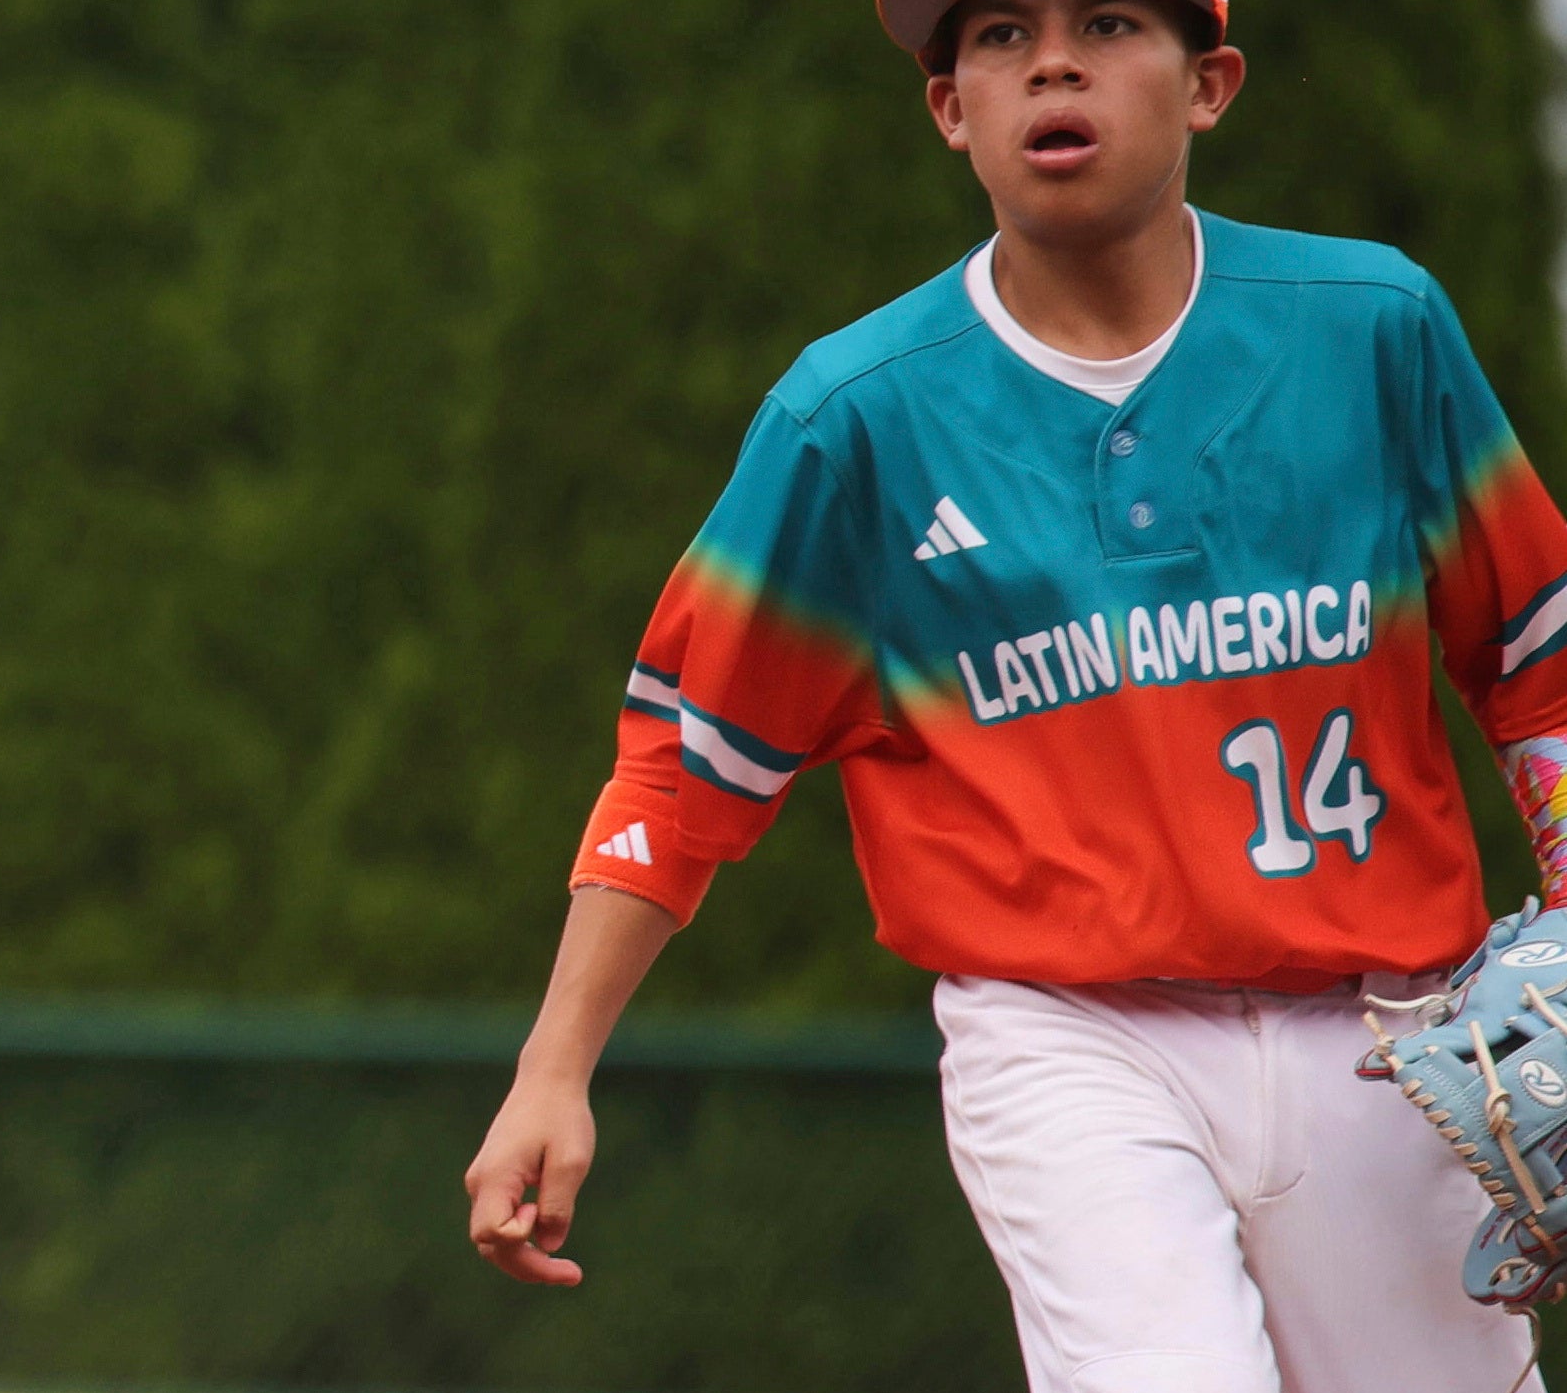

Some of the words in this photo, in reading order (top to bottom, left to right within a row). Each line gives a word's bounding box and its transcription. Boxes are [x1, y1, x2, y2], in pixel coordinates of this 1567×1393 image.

[958, 612, 1118, 721] LATIN
[1128, 579, 1372, 682] AMERICA
[1224, 713, 1382, 873] 14
